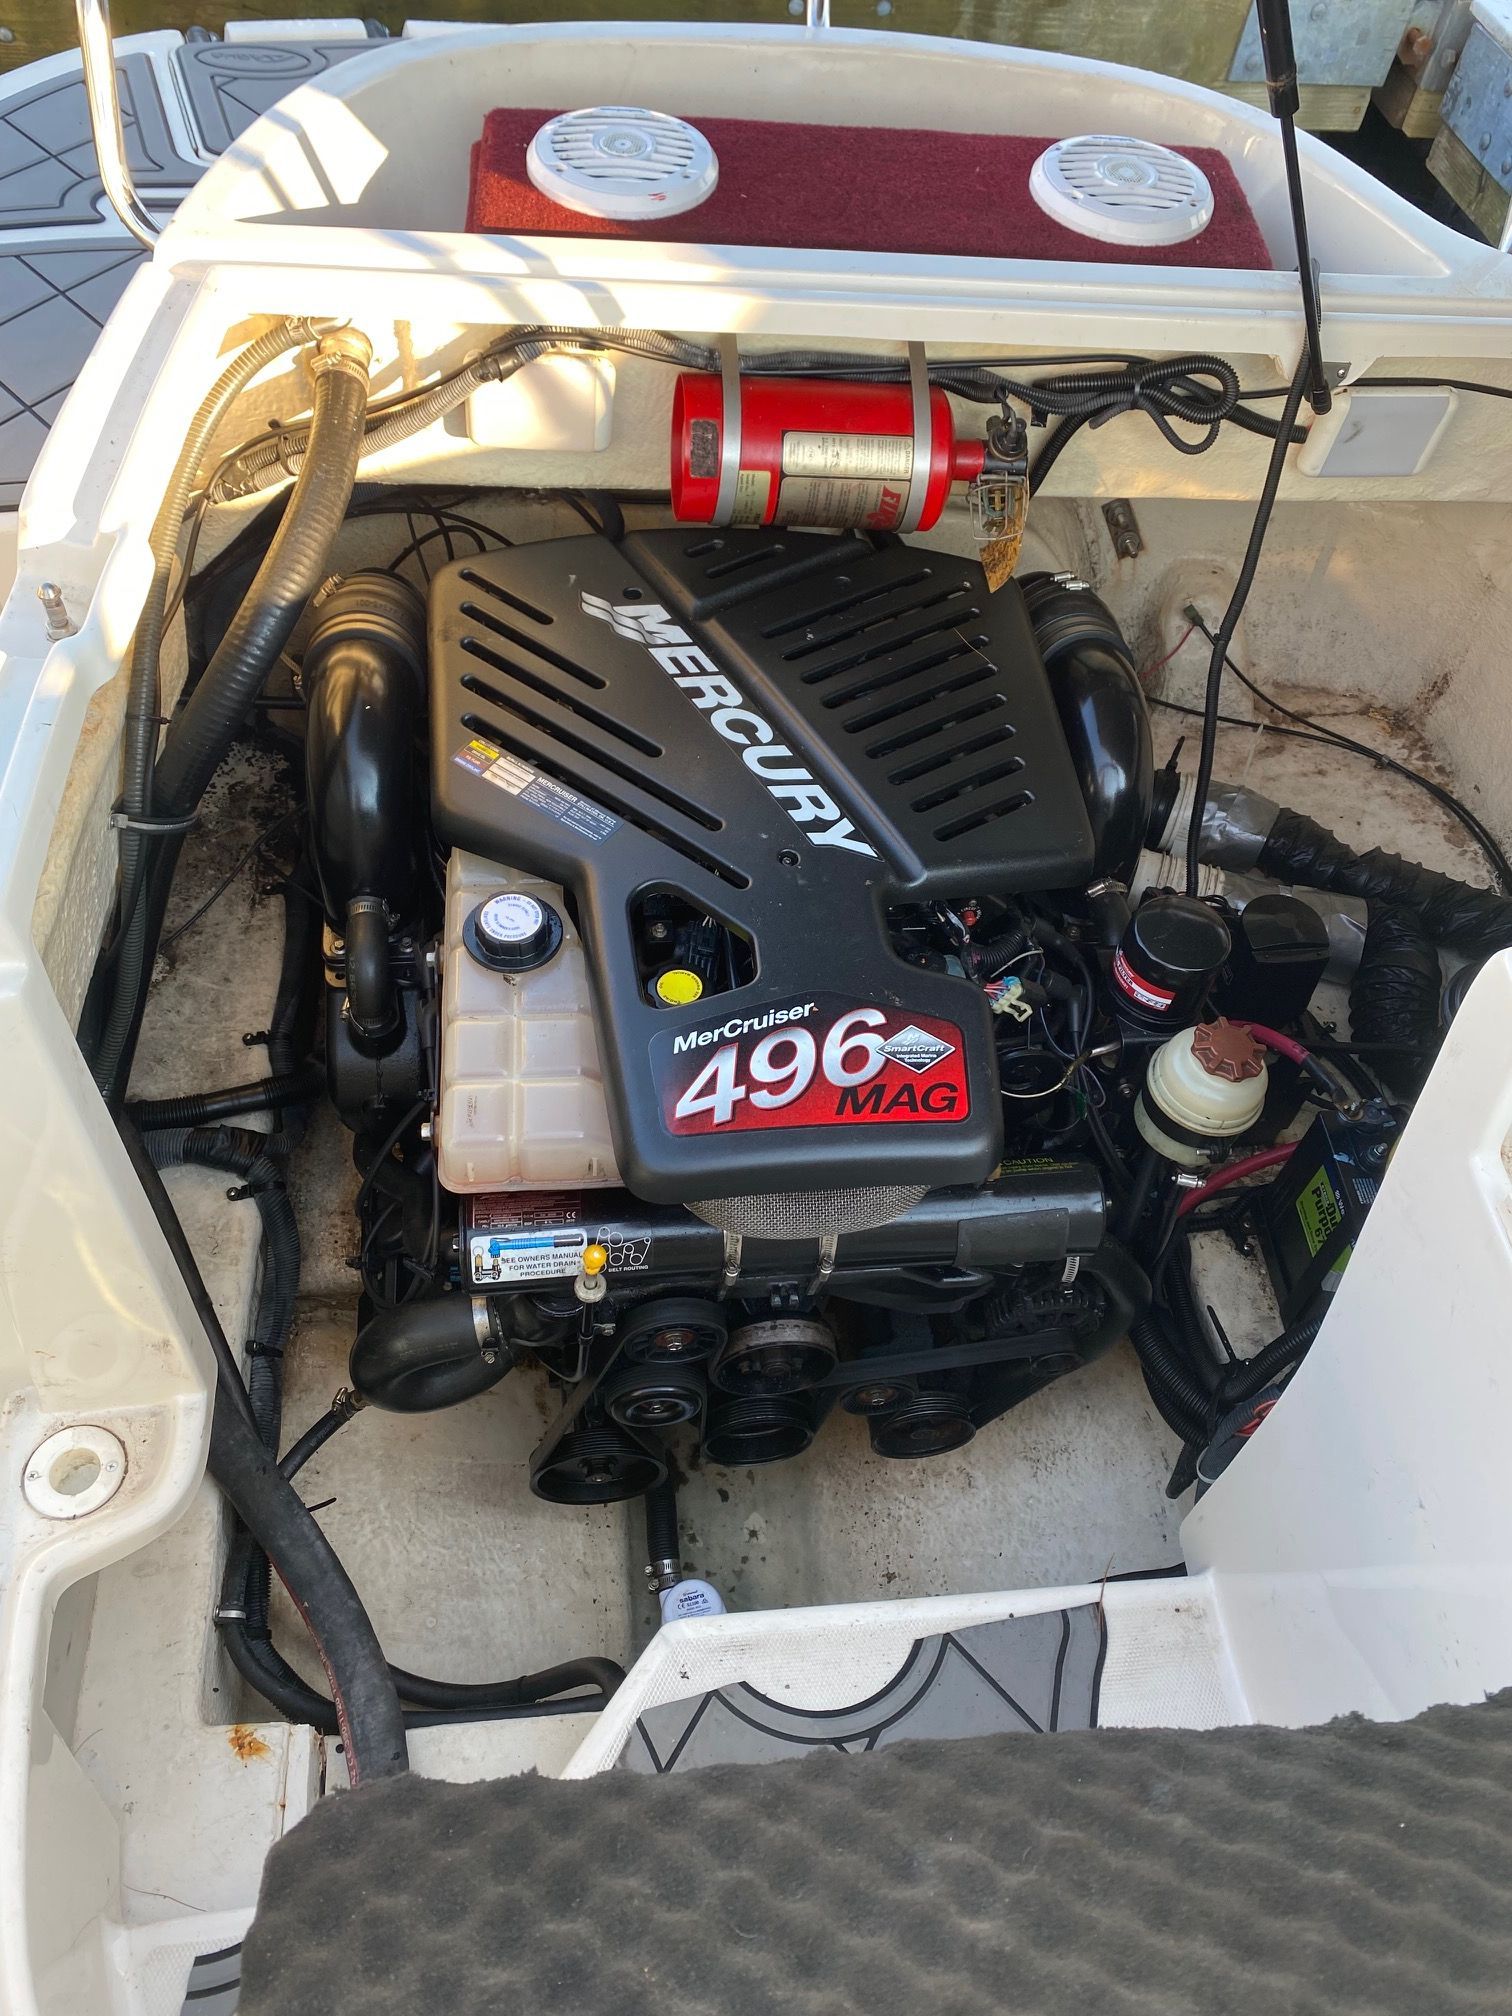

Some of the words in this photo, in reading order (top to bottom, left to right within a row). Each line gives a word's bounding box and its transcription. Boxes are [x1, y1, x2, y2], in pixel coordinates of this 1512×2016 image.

[590, 596, 879, 858] MERCURY
[537, 777, 578, 802] MERCRUISER
[673, 1002, 815, 1054] MerCruiser
[883, 1045, 945, 1053] SmartCraft
[674, 1007, 888, 1126] 496
[835, 1082, 959, 1115] MAG
[1003, 1157, 1054, 1166] CAUTION
[1311, 1186, 1333, 1236] Purpo
[518, 1254, 550, 1263] OWNERS
[552, 1252, 583, 1261] MANUAL
[553, 1260, 577, 1268] DRAIN
[520, 1269, 566, 1277] PROCEDURE
